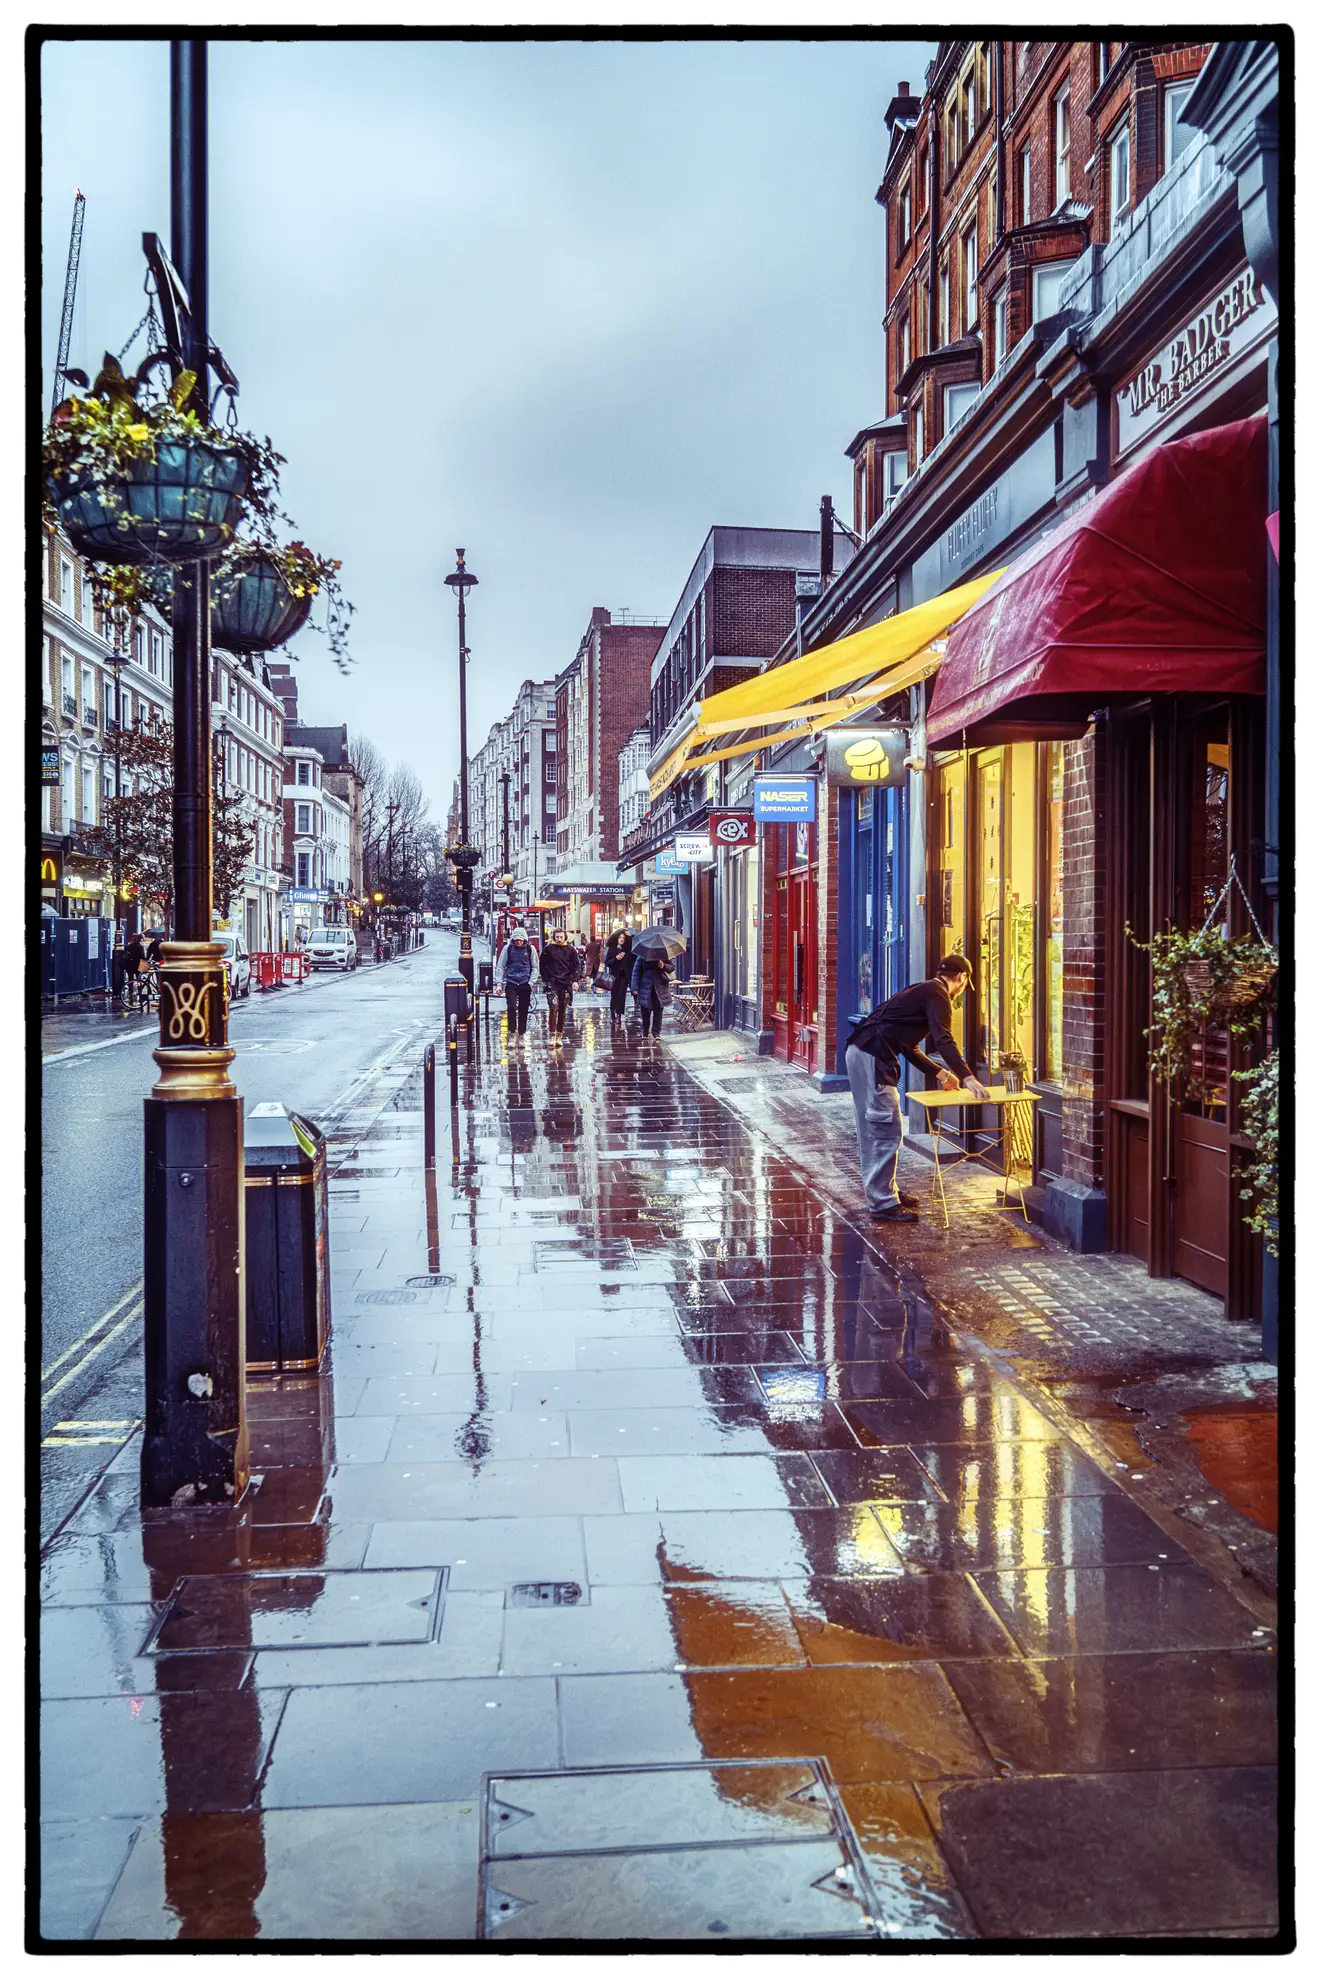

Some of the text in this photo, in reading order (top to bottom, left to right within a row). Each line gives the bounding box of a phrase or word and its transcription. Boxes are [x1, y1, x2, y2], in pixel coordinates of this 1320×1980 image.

[1128, 269, 1258, 413] MR. BADGER
[1154, 340, 1224, 408] THE BARBER
[760, 791, 809, 802] NASER
[760, 805, 809, 813] SUPERMARKET
